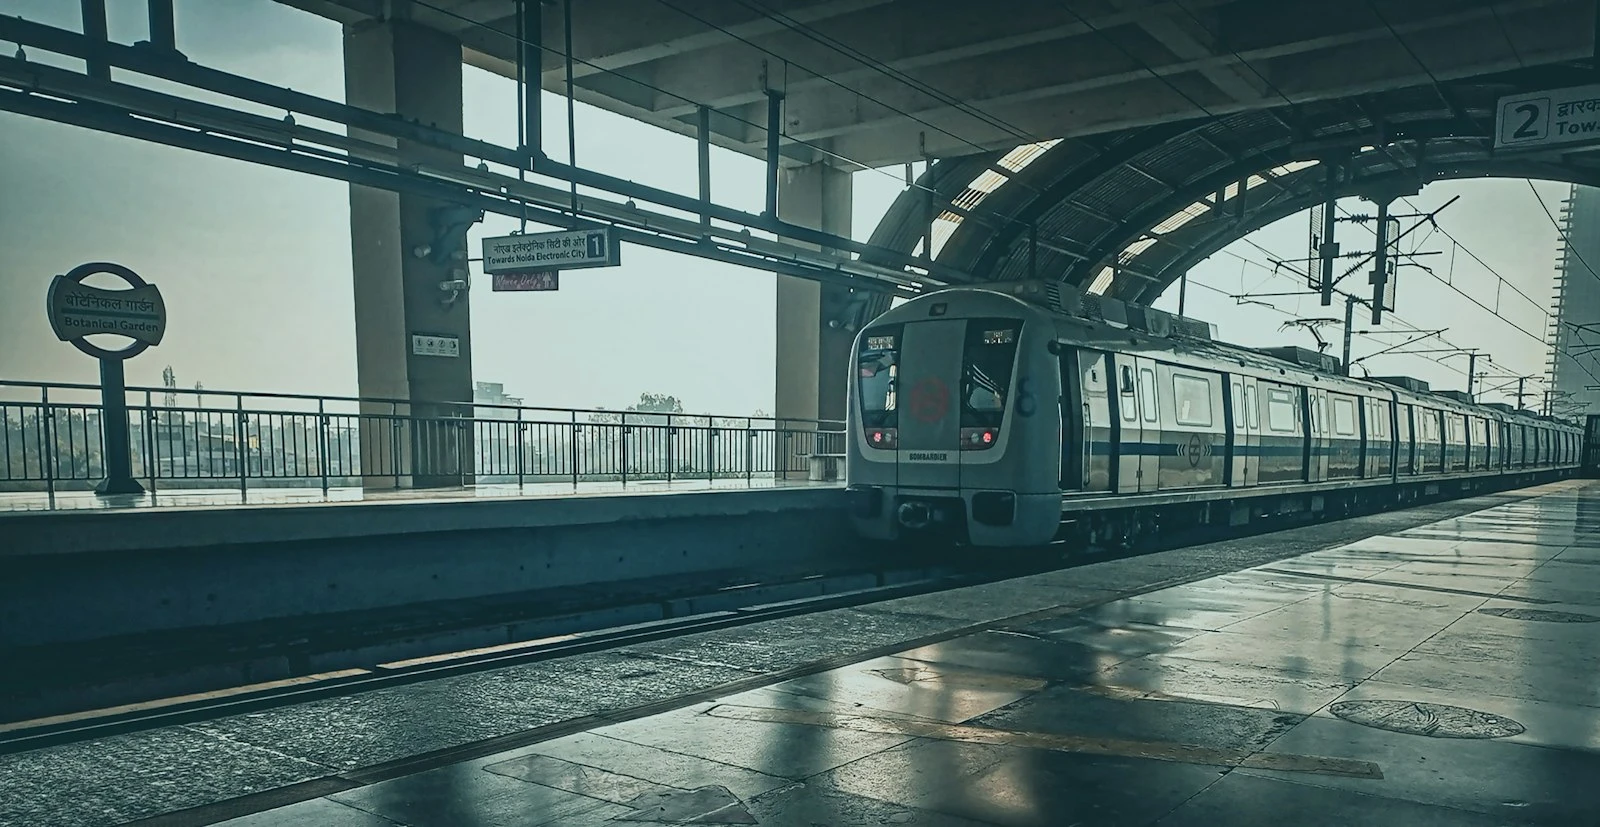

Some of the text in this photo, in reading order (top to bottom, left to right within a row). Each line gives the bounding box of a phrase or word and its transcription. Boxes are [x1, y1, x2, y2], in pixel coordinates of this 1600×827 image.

[1513, 104, 1539, 139] 2
[1556, 121, 1600, 136] Tow
[547, 237, 561, 249] सिटी
[562, 236, 571, 248] की
[572, 235, 586, 247] ओर
[592, 236, 600, 256] 1
[488, 249, 586, 265] Towards Noida Electronic City
[126, 298, 155, 312] गार्डन
[64, 316, 159, 333] Botanical Garden
[909, 453, 947, 461] BOMBARDIER
